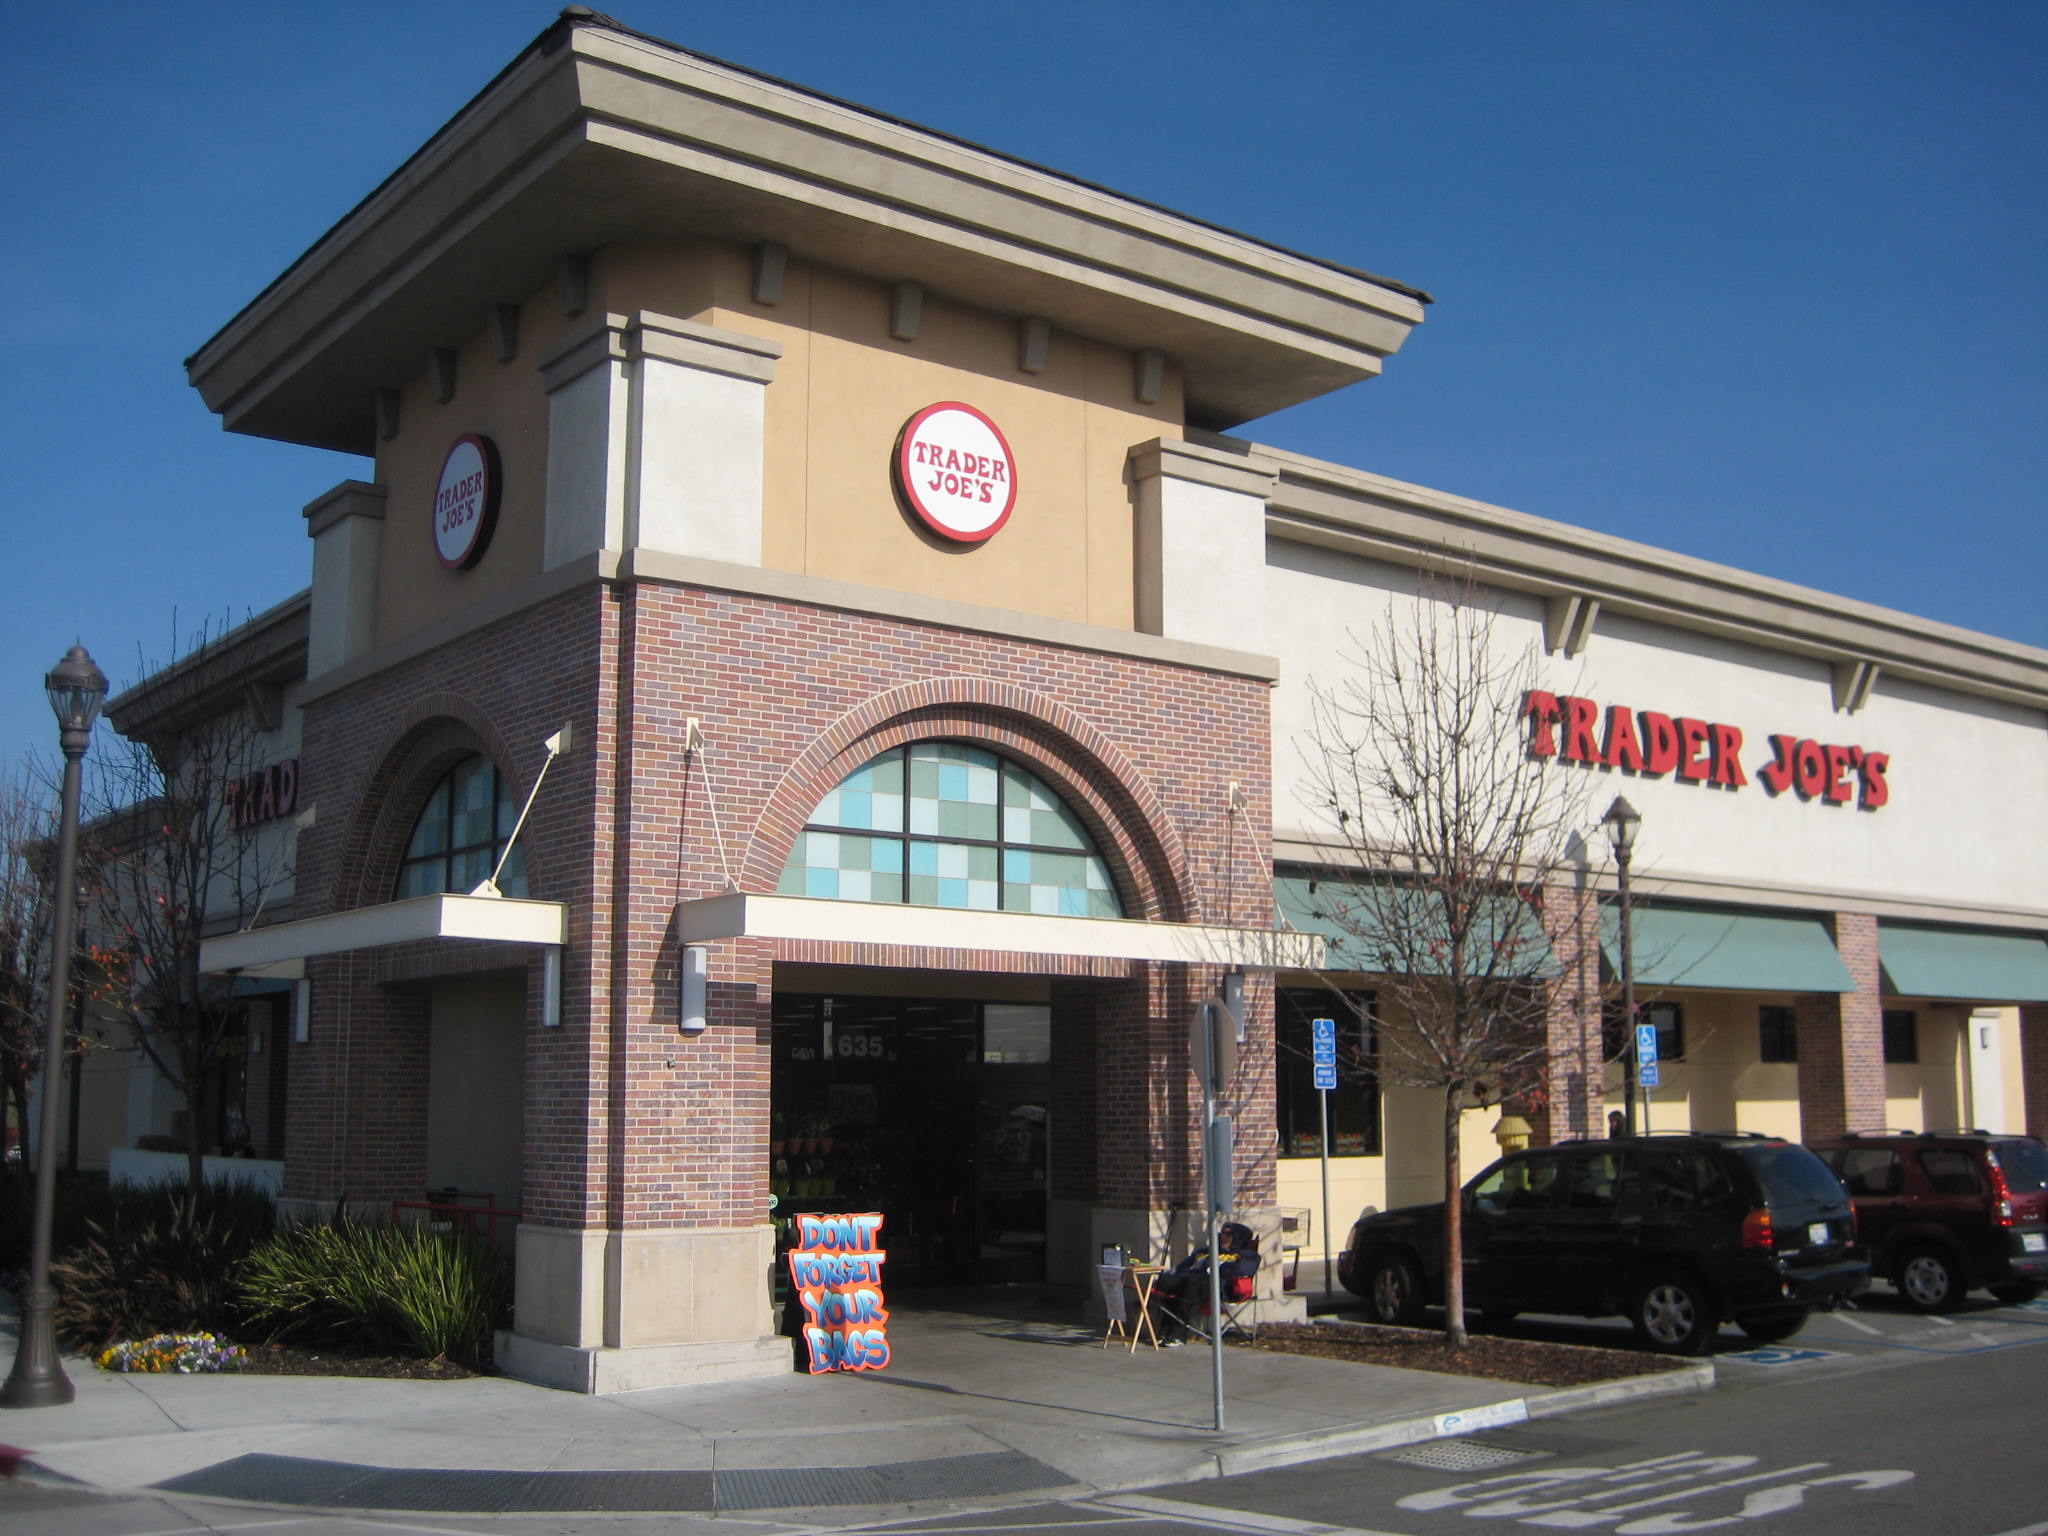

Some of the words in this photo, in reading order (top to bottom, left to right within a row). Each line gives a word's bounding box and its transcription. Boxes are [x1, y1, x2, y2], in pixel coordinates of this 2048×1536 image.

[913, 441, 1006, 482] TRADER
[438, 471, 482, 513] TRADER
[928, 470, 994, 503] JOE'S
[442, 498, 475, 533] JOE'S
[1523, 690, 1747, 791] TRADER
[1756, 734, 1890, 812] JOE'S
[226, 758, 300, 831] TRAD
[838, 1034, 883, 1057] 635
[801, 1216, 882, 1251] DONT
[793, 1253, 886, 1288] FORGET
[804, 1289, 883, 1327] YOUR
[807, 1328, 889, 1372] BAGS
[1395, 1451, 1915, 1534] STOP
